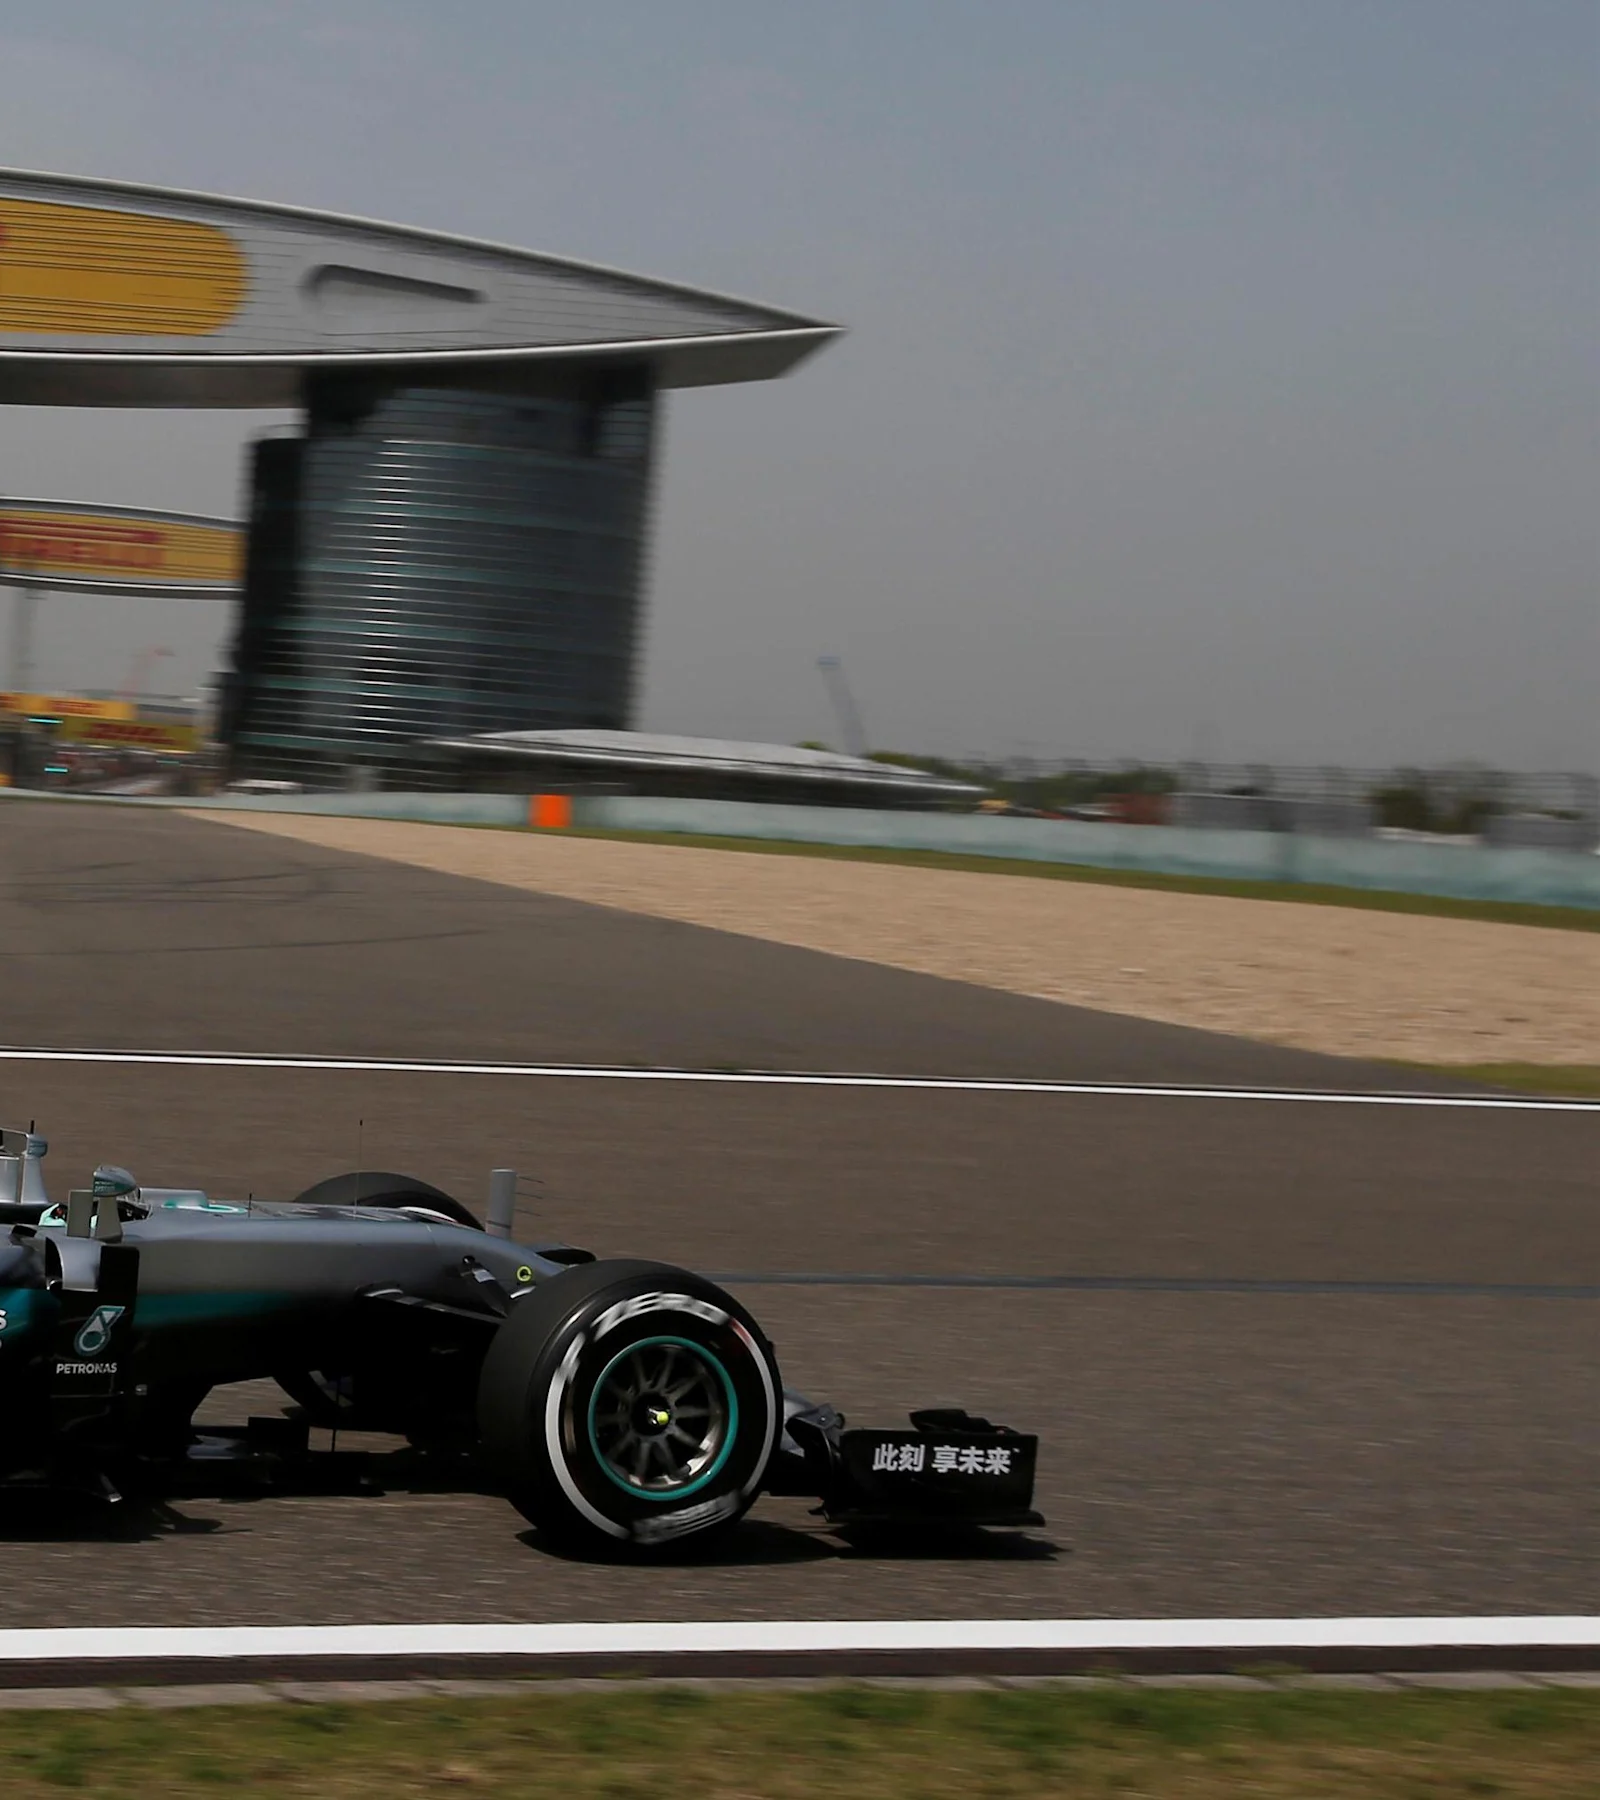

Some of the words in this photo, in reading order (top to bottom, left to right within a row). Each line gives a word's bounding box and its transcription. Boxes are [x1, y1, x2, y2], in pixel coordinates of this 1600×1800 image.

[56, 1362, 118, 1374] PETRONAS
[872, 1443, 926, 1472] 此刻
[931, 1445, 1012, 1475] 享未来
